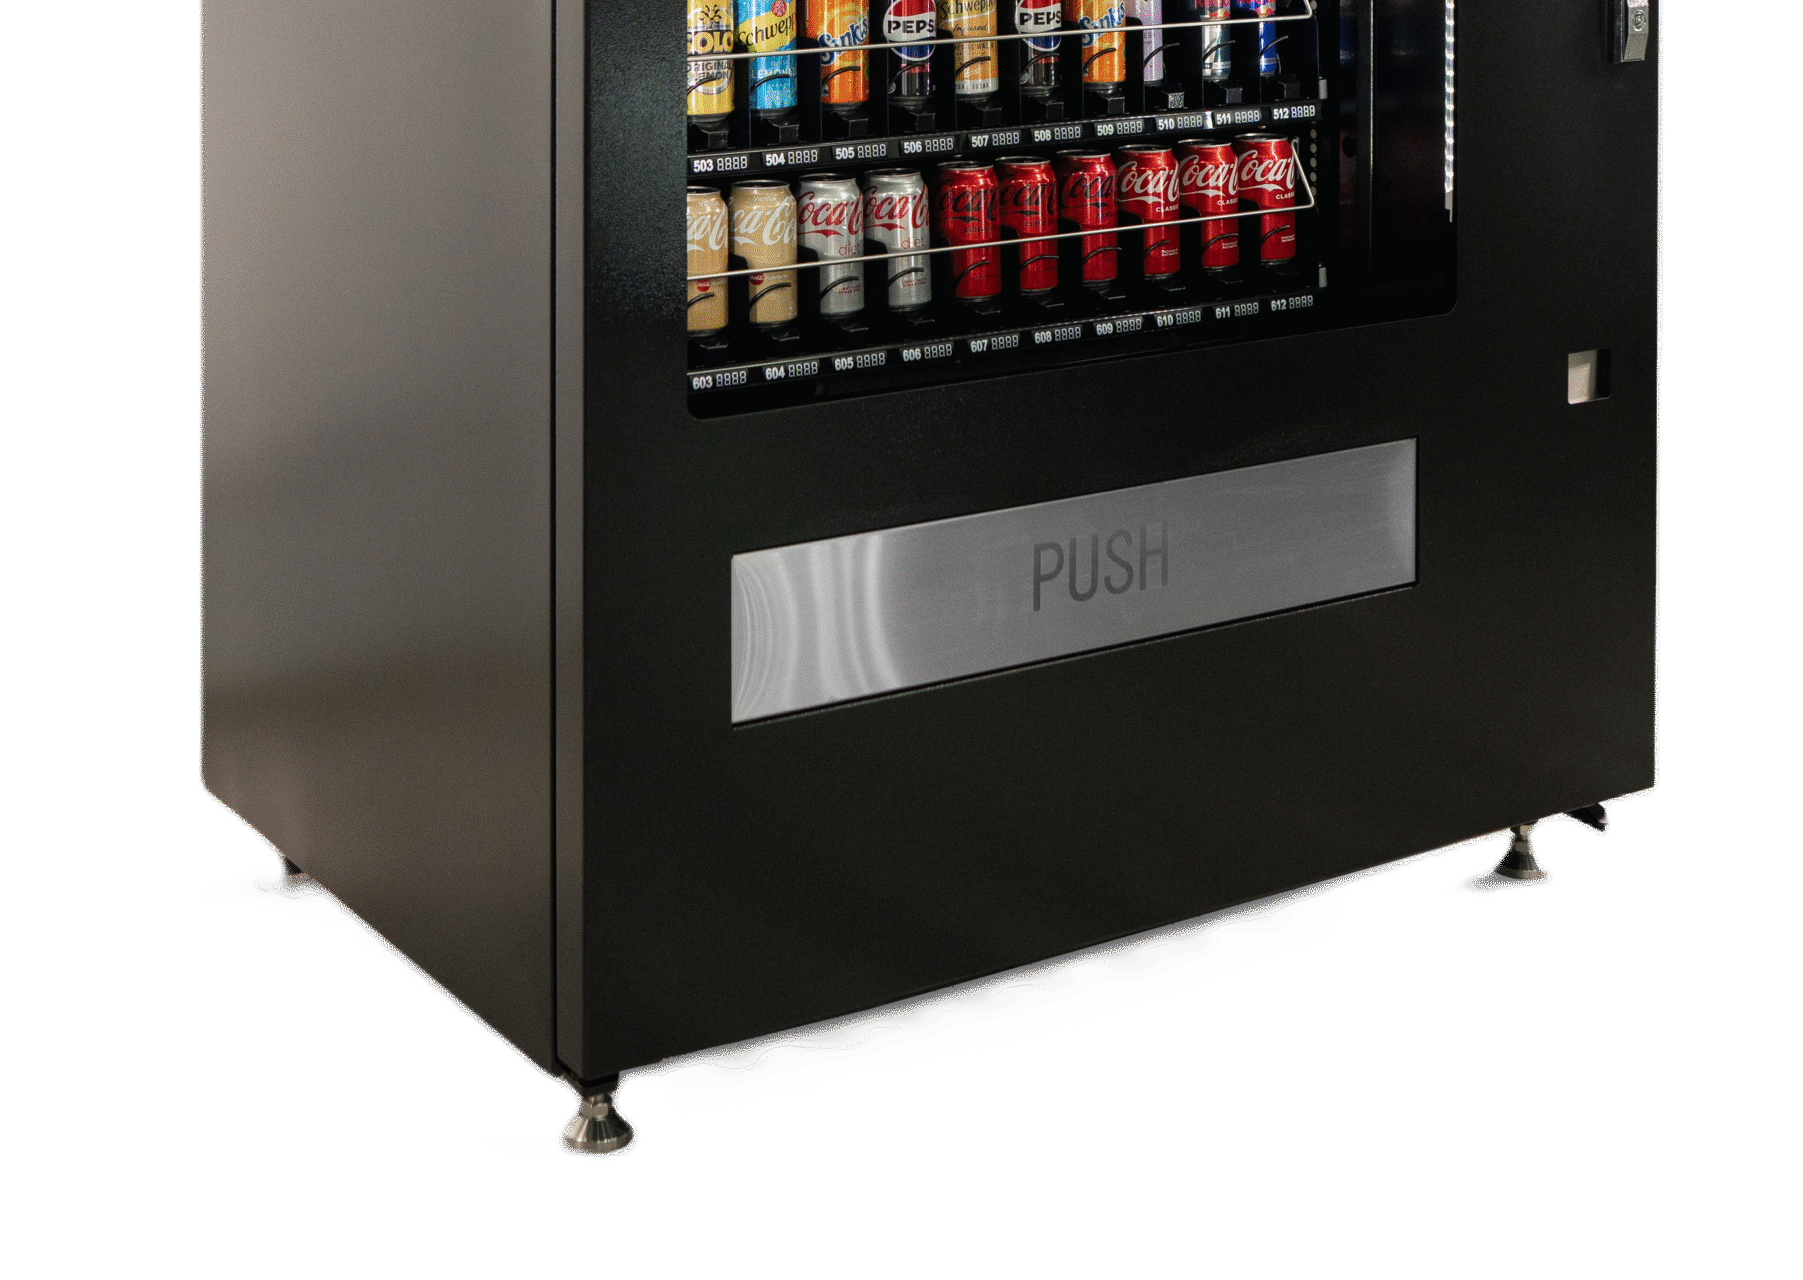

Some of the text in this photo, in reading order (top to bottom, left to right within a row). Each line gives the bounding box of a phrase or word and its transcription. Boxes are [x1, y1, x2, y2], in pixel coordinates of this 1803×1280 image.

[1019, 11, 1062, 25] PEPS
[887, 19, 935, 34] PEPS
[1217, 113, 1231, 124] 511
[1274, 108, 1289, 119] 512
[1097, 123, 1114, 135] 509
[1158, 119, 1175, 130] 510
[972, 135, 988, 147] 507
[1034, 130, 1051, 141] 508
[836, 147, 854, 159] 505
[904, 141, 922, 153] 506
[766, 153, 785, 165] 504
[694, 159, 713, 172] 503
[839, 242, 860, 256] diet
[901, 238, 924, 250] diet
[1271, 299, 1286, 310] 612
[1216, 307, 1230, 318] 611
[1157, 314, 1174, 326] 610
[1097, 322, 1113, 335] 609
[1035, 331, 1052, 343] 608
[971, 339, 988, 352] 607
[903, 348, 921, 361] 606
[835, 357, 853, 370] 605
[766, 366, 785, 379] 604
[693, 375, 713, 389] 603
[1033, 521, 1168, 612] PUSH
